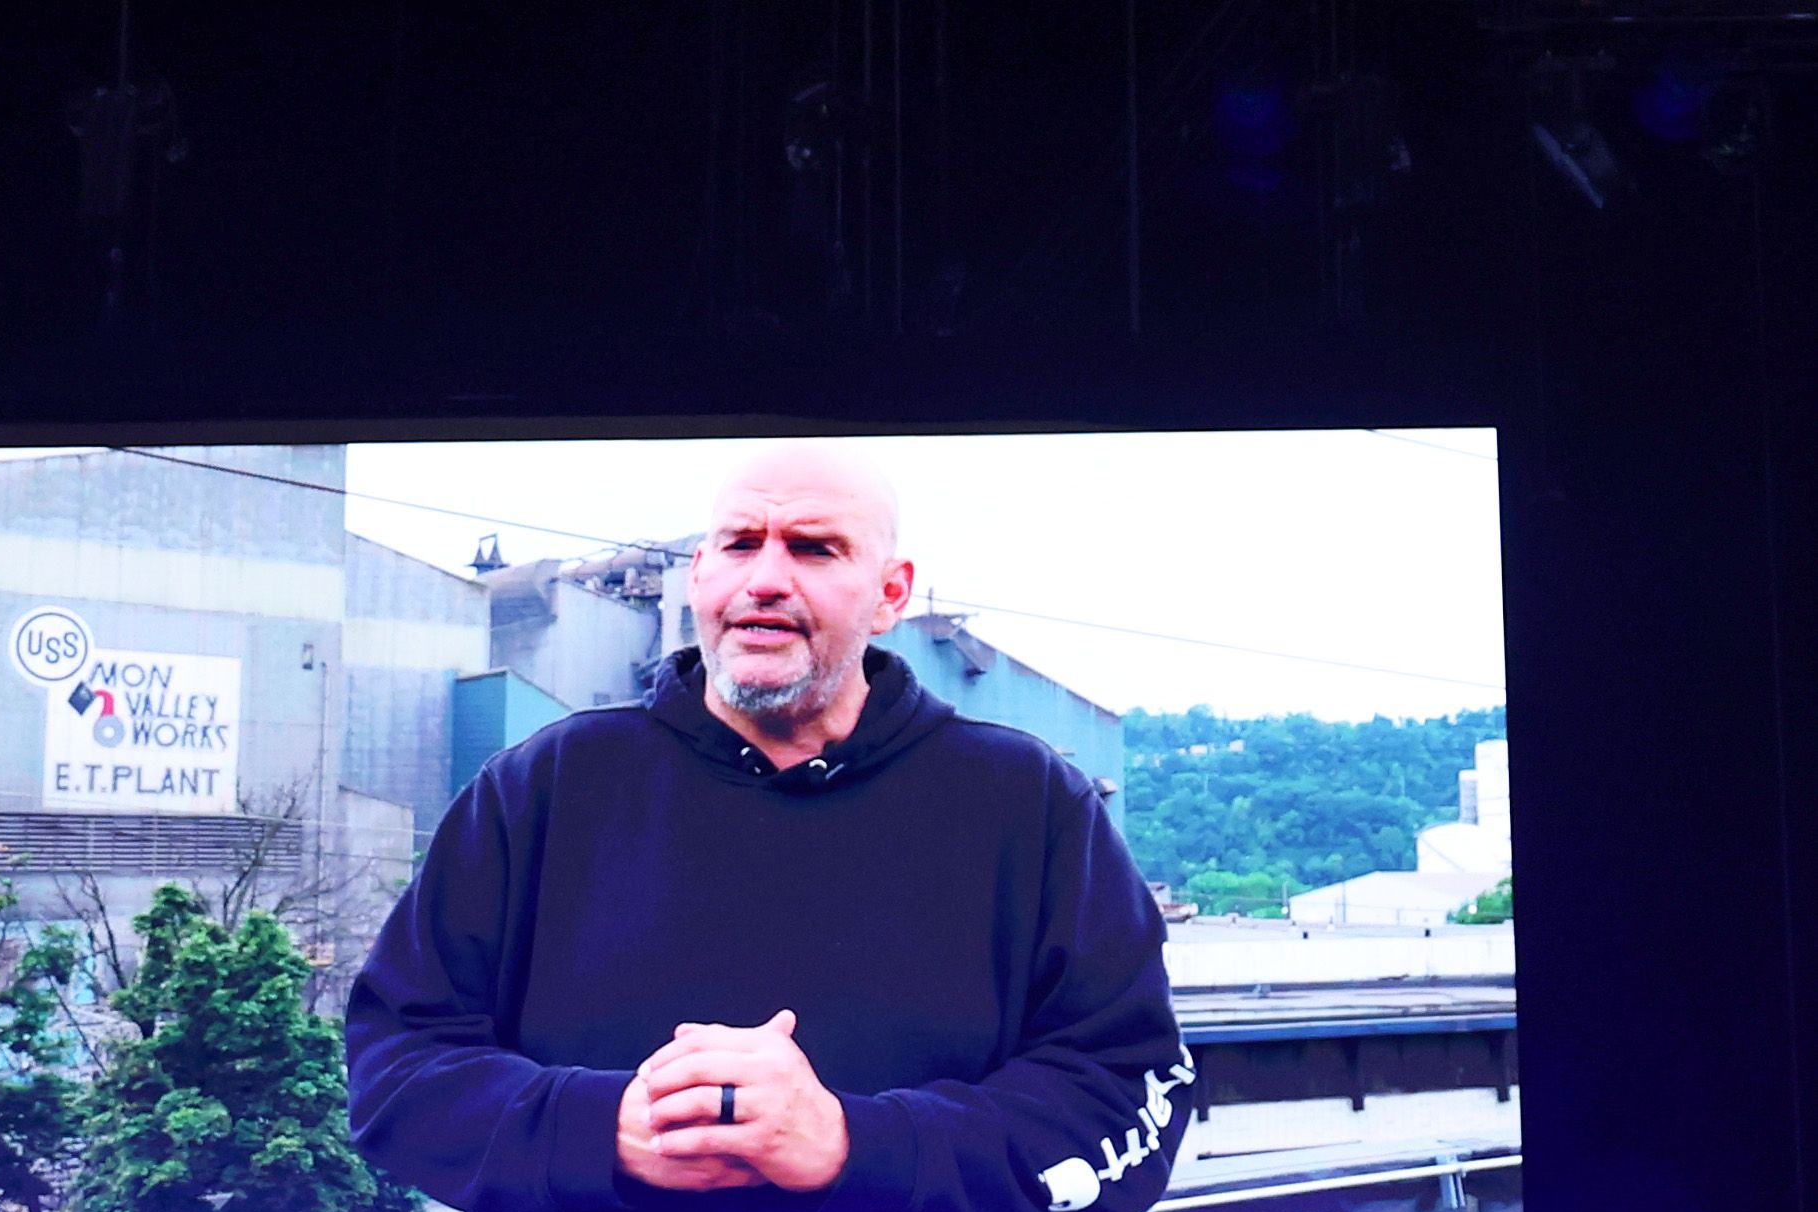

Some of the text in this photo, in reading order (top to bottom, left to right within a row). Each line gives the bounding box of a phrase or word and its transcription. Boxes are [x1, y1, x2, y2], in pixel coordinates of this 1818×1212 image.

[26, 629, 79, 665] USS
[89, 662, 173, 689] MON
[125, 692, 218, 721] VALLEY
[131, 719, 231, 750] WORKS
